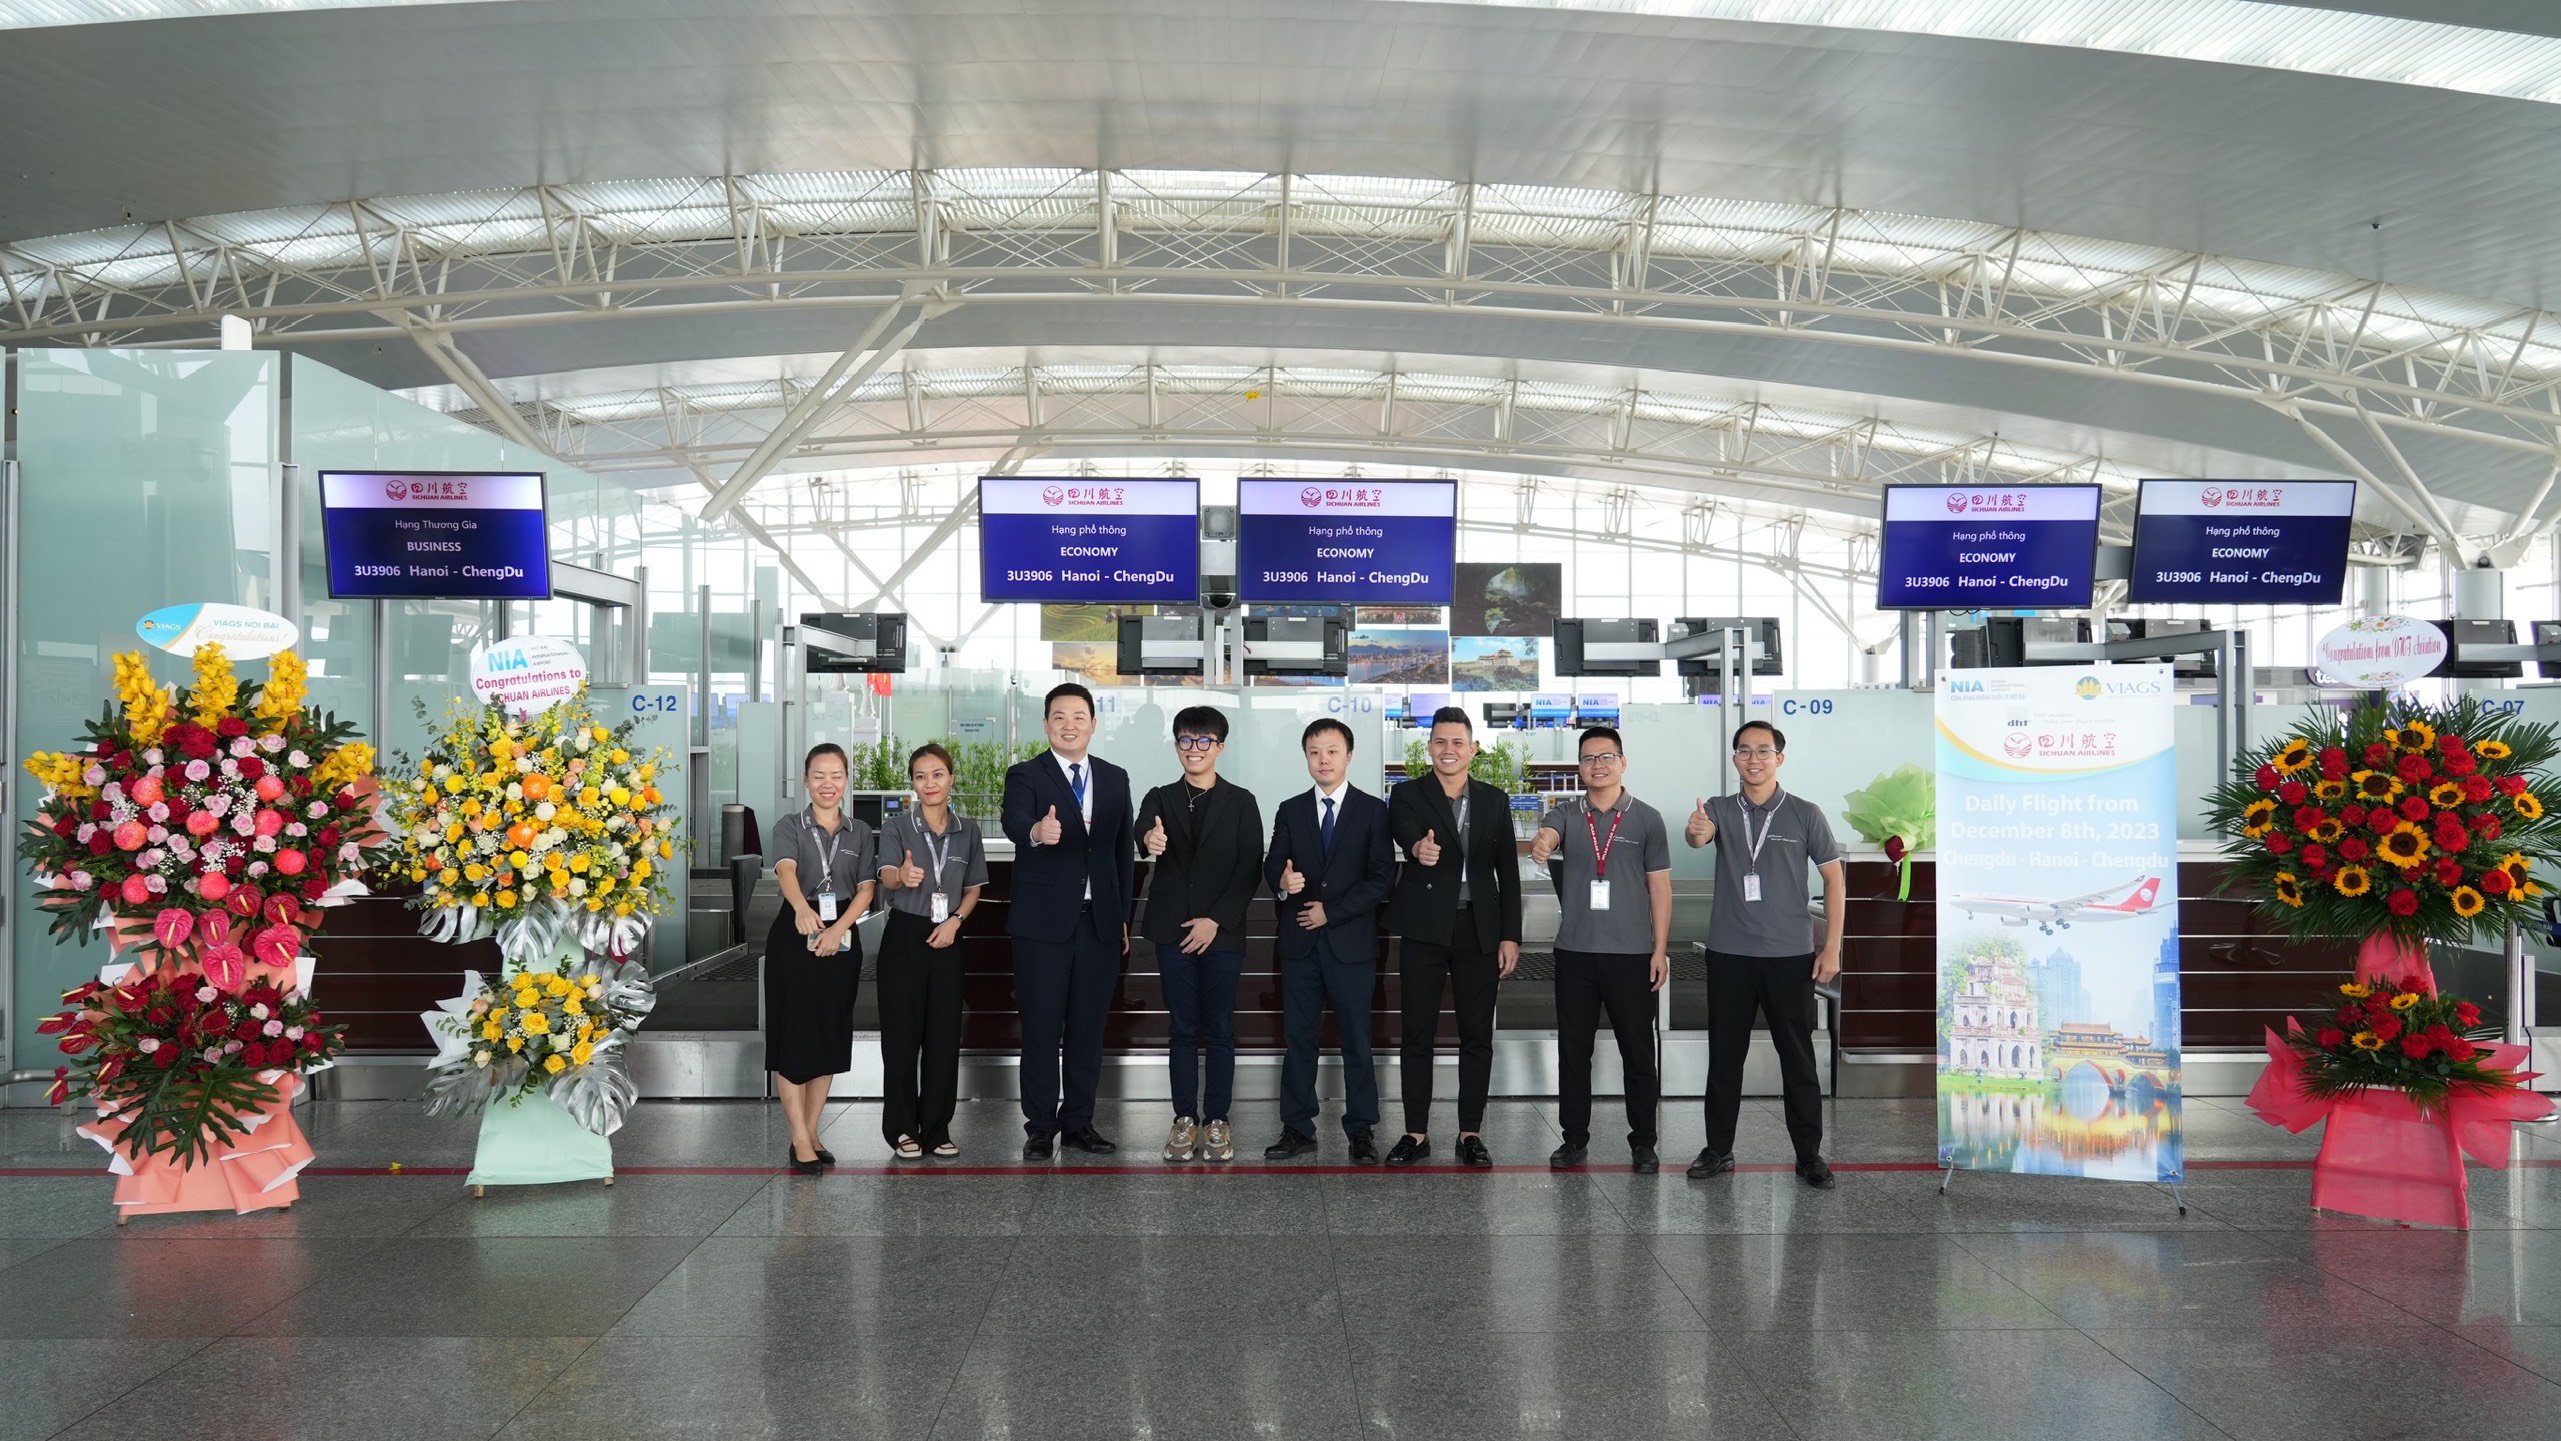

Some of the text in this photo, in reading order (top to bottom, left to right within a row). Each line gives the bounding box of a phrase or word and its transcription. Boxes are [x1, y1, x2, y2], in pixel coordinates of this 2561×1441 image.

[411, 482, 468, 495] 四川航空
[1068, 488, 1124, 500] 四川航空
[2227, 488, 2282, 501] 四川航空
[1326, 489, 1382, 502] 四川航空
[1972, 494, 2027, 506] 四川航空
[395, 520, 477, 531] Hạng Thương Gia
[1052, 524, 1126, 536] Hạng phổ thông
[1309, 525, 1383, 538] Hạng phổ thông
[2206, 525, 2280, 537] Hạng phổ thông
[1952, 530, 2026, 542] Hạng phổ thông
[407, 542, 462, 552] BUSINESS
[1060, 547, 1118, 556] ECONOMY
[1317, 548, 1374, 558] ECONOMY
[2212, 548, 2269, 558] ECONOMY
[1960, 553, 2016, 563] ECONOMY
[354, 566, 400, 576] 3U3906
[410, 566, 449, 576] Hanoi
[462, 566, 524, 580] ChengDu
[1007, 570, 1052, 581] 3U3906
[1062, 570, 1100, 581] Hanoi
[1114, 570, 1174, 584] ChengDu
[1263, 572, 1308, 582] 3U3906
[1317, 572, 1356, 583] Hanoi
[1368, 572, 1429, 586] ChengDu
[2156, 572, 2201, 582] 3U3906
[2210, 572, 2248, 583] Hanoi
[2261, 572, 2321, 585] ChengDu
[1905, 576, 1950, 587] 3U3906
[1958, 576, 1996, 587] Hanoi
[2009, 576, 2068, 589] ChengDu
[214, 619, 242, 627] VIAGS
[195, 626, 287, 643] Congratulations!
[2375, 639, 2391, 662] from
[487, 648, 528, 672] NIA
[476, 669, 581, 690] Congratulations to
[1951, 679, 1984, 693] NIA
[2106, 681, 2161, 694] VIAGS
[499, 686, 570, 704] CHUAN AIRLINES
[632, 695, 677, 712] C-12
[1096, 696, 1116, 712] 11
[1327, 696, 1372, 713] C-10
[1783, 699, 1833, 715] C-09
[2482, 700, 2525, 715] C-07
[2007, 719, 2028, 727] dht
[2038, 733, 2117, 749] 四川航空
[1965, 795, 2139, 816] Daily Flight from
[1951, 822, 2160, 842] December 8th, 2023
[1943, 850, 2016, 868] Chengdu
[2029, 852, 2079, 867] Hanoi
[2092, 852, 2169, 872] Chengdu
